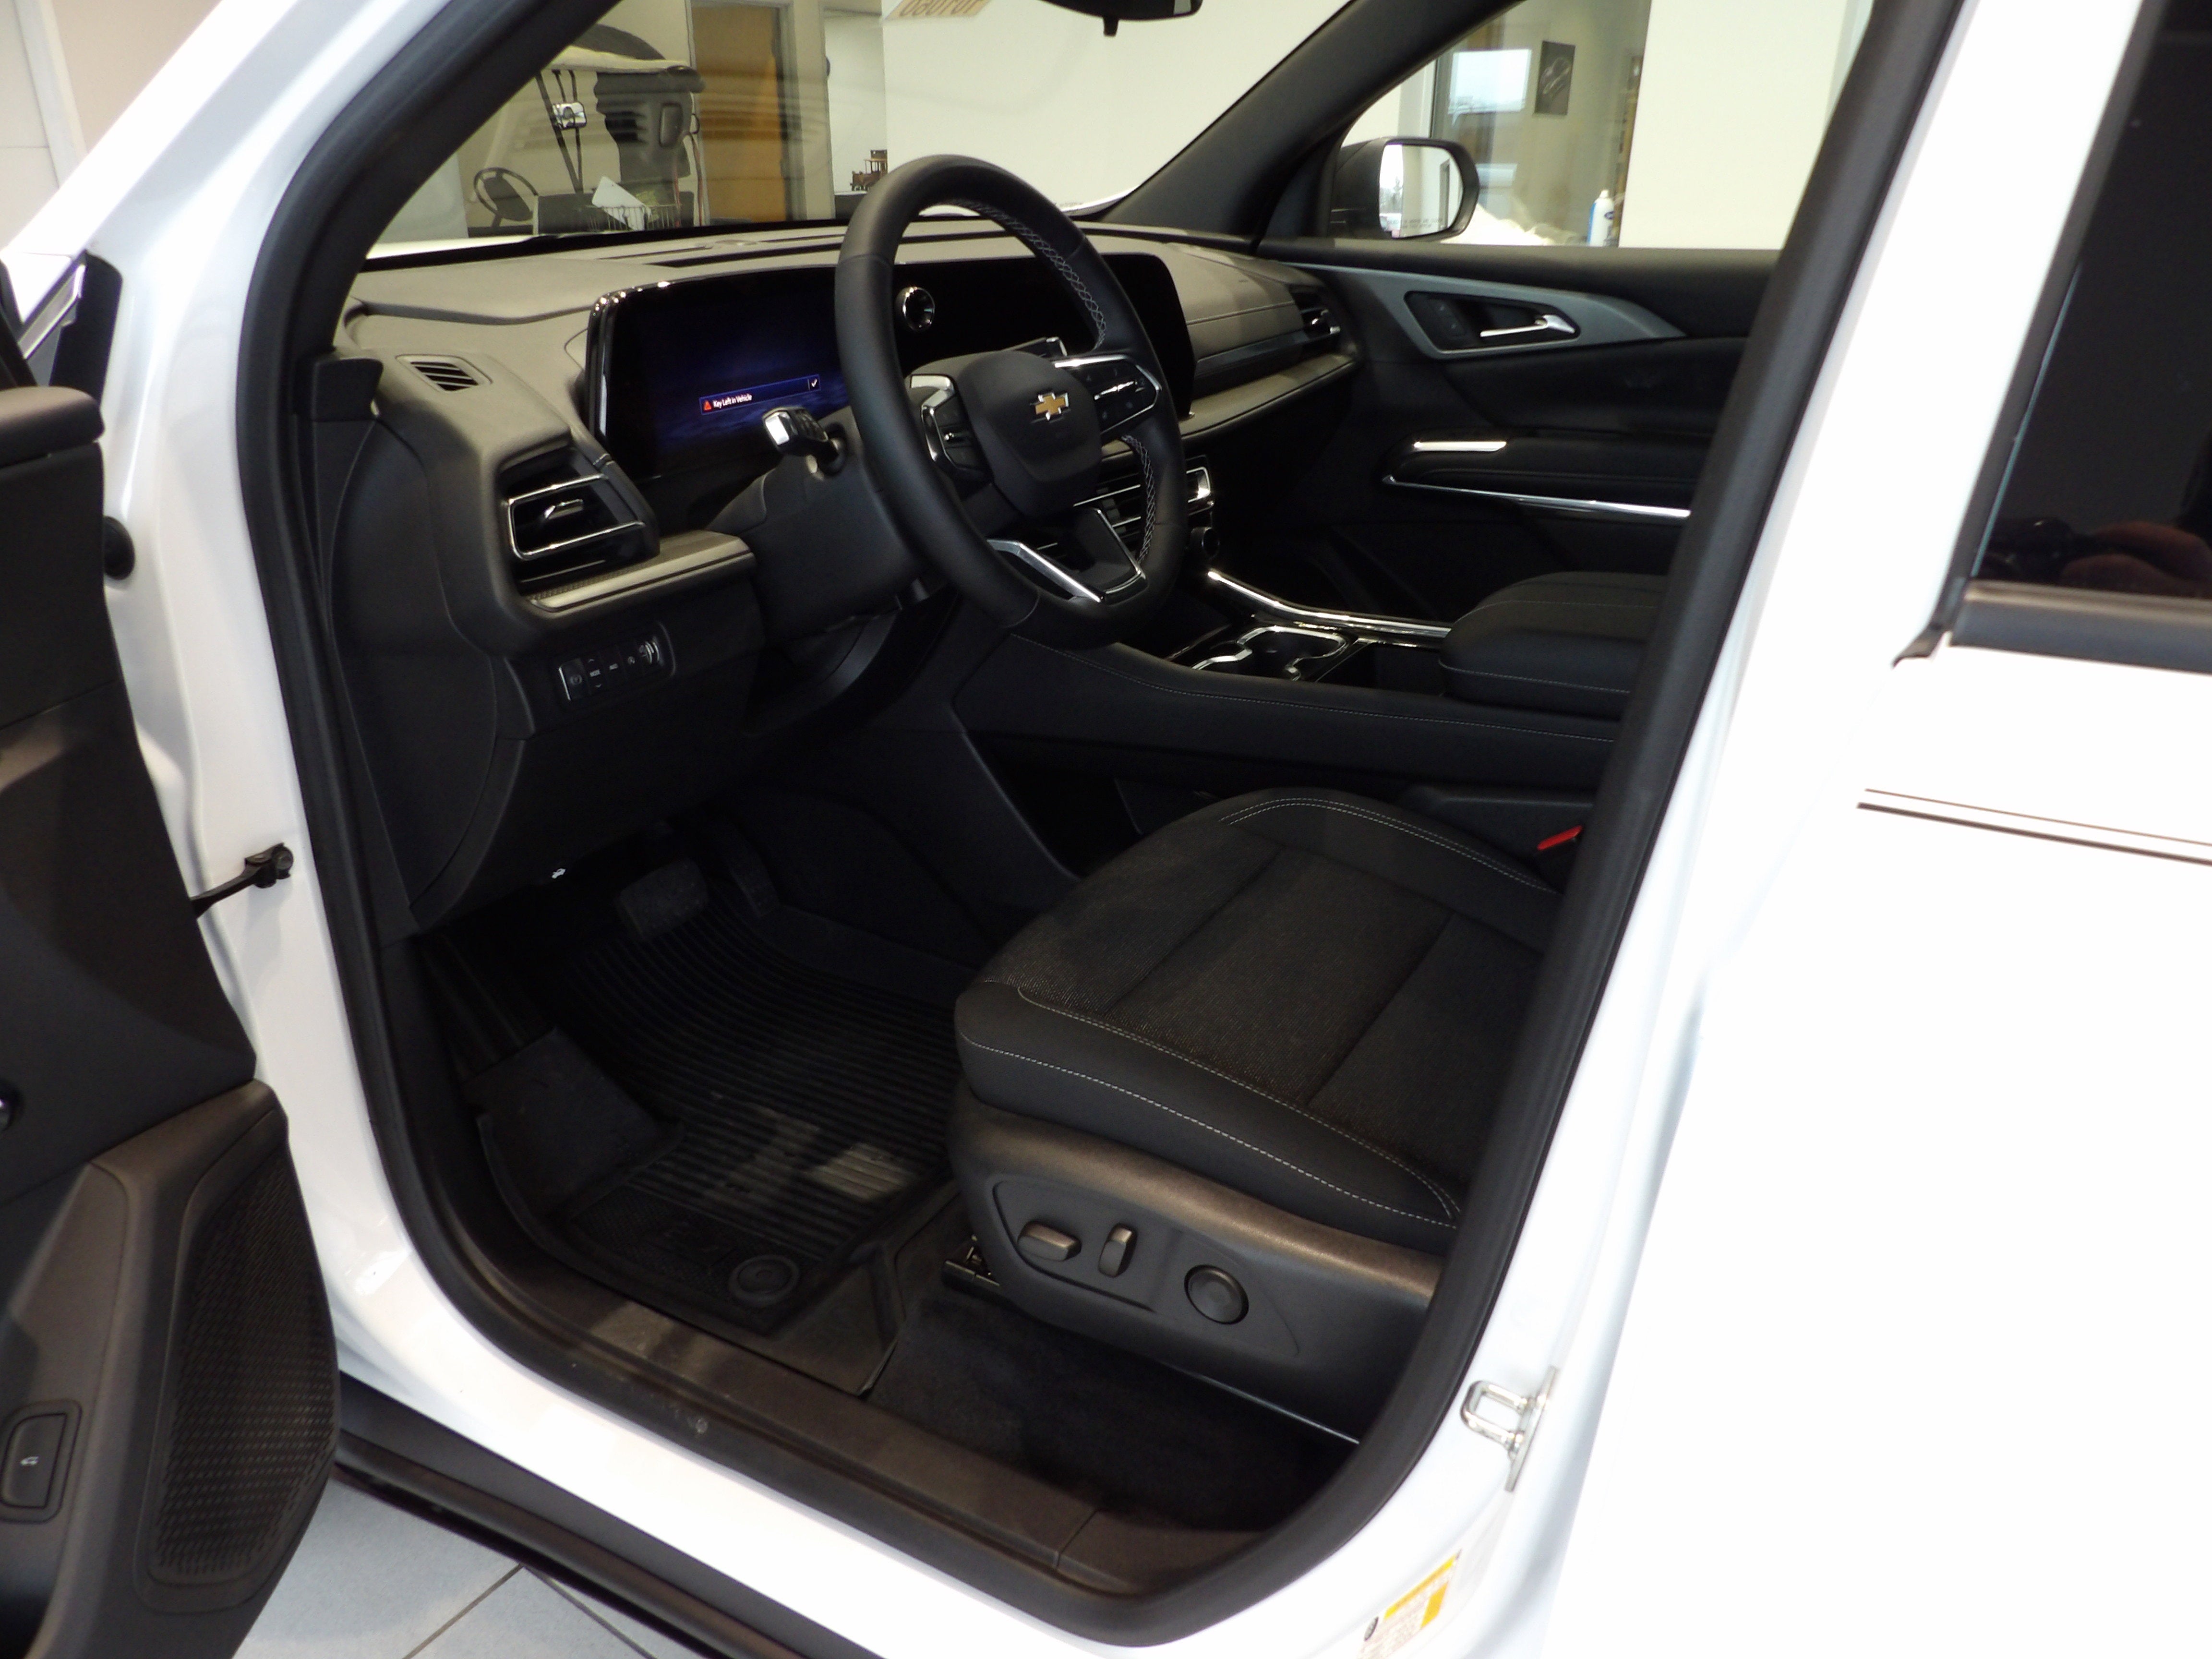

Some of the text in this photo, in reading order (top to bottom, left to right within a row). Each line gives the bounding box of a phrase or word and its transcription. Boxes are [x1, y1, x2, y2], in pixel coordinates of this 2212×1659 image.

[713, 400, 722, 409] Key
[722, 397, 732, 406] Left
[736, 394, 752, 403] Vehicle
